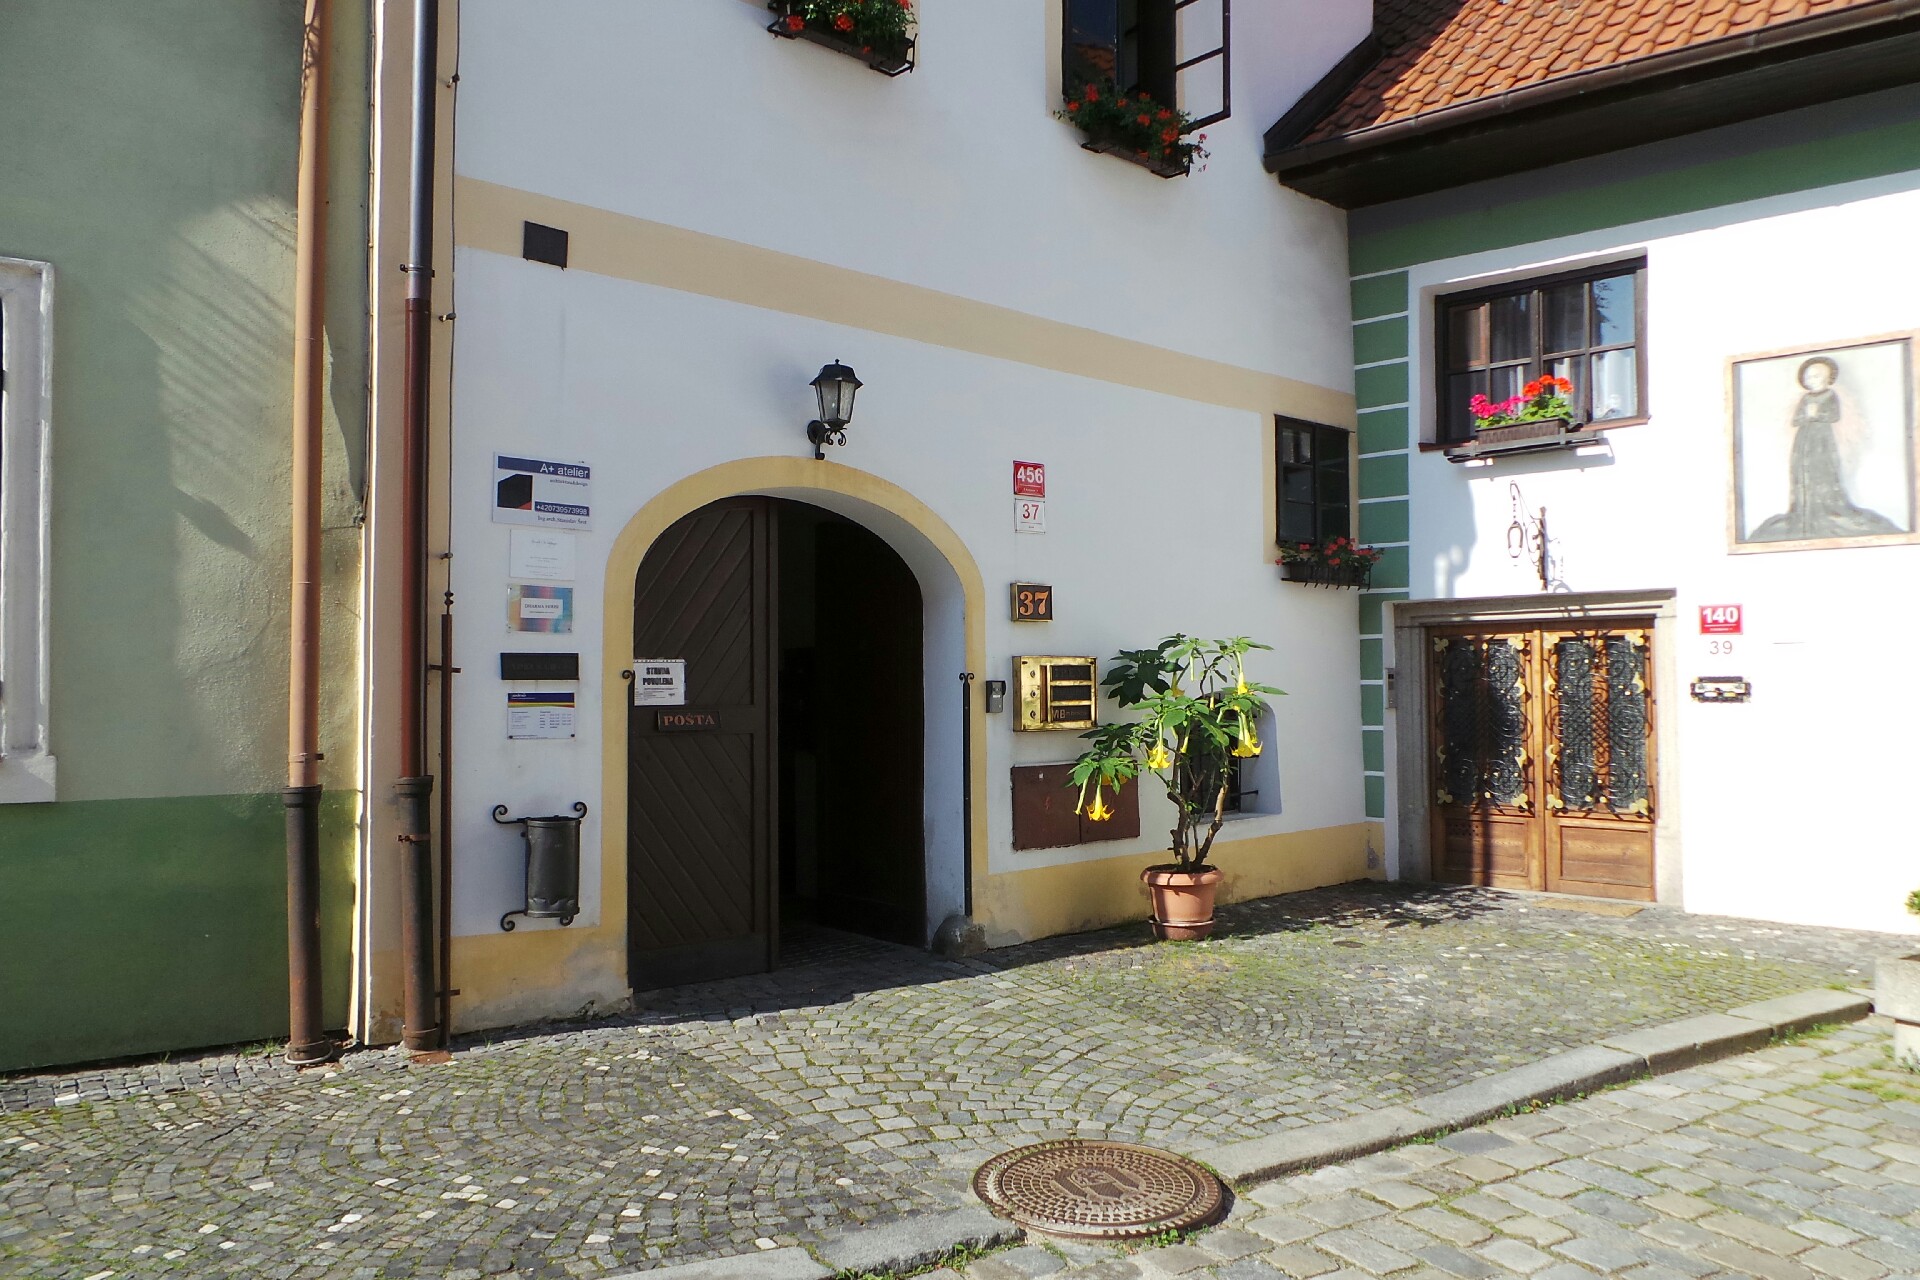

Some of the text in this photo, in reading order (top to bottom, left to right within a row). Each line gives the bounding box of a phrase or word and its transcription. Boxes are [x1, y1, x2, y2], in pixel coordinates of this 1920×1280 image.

[540, 463, 588, 478] A+ atelier
[1017, 466, 1044, 484] 456
[1022, 503, 1040, 520] 37
[1019, 591, 1049, 616] 37
[1702, 606, 1739, 624] 140
[1709, 640, 1733, 655] 39
